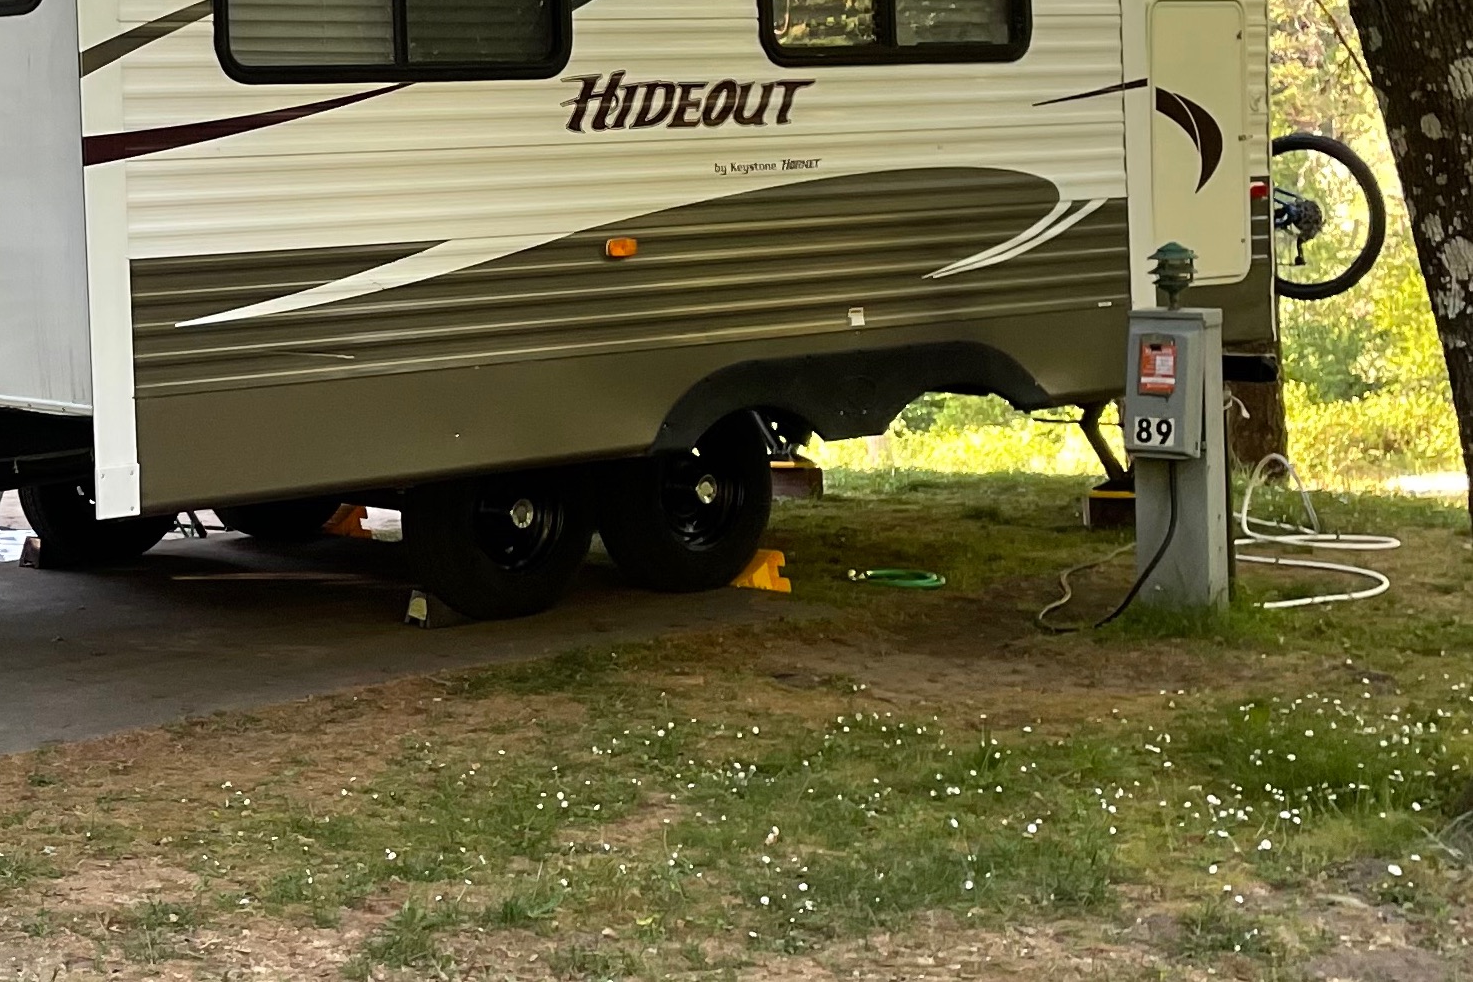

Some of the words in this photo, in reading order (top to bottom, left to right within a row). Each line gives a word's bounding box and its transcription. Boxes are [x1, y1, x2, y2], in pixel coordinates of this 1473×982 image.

[560, 69, 816, 133] HIDEOUT
[714, 163, 727, 176] by
[730, 162, 777, 174] Keystone
[1136, 418, 1172, 445] 89
